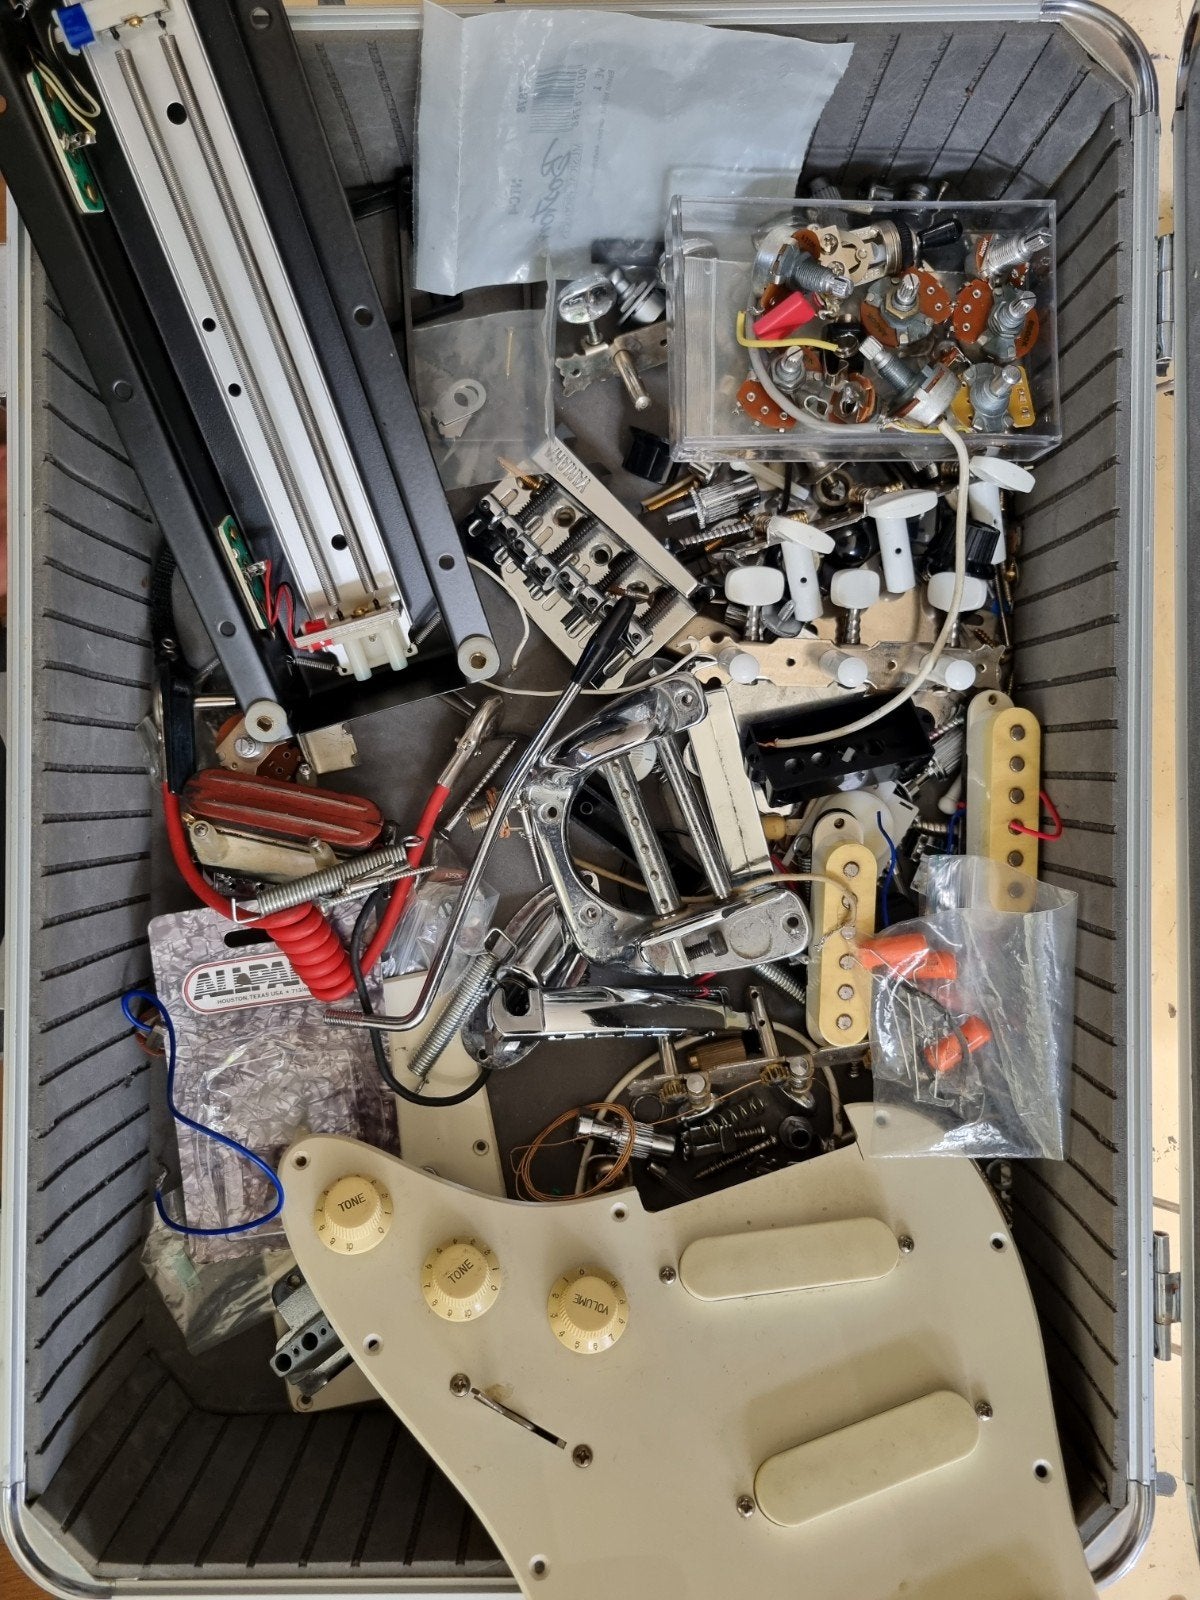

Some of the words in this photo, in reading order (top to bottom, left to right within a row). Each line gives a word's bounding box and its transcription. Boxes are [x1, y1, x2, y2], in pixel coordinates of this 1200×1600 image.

[249, 991, 270, 1000] TEXAS
[270, 989, 284, 997] USA
[337, 1192, 367, 1213] TONE
[447, 1258, 475, 1284] TONE
[572, 1293, 610, 1316] VOLUME
